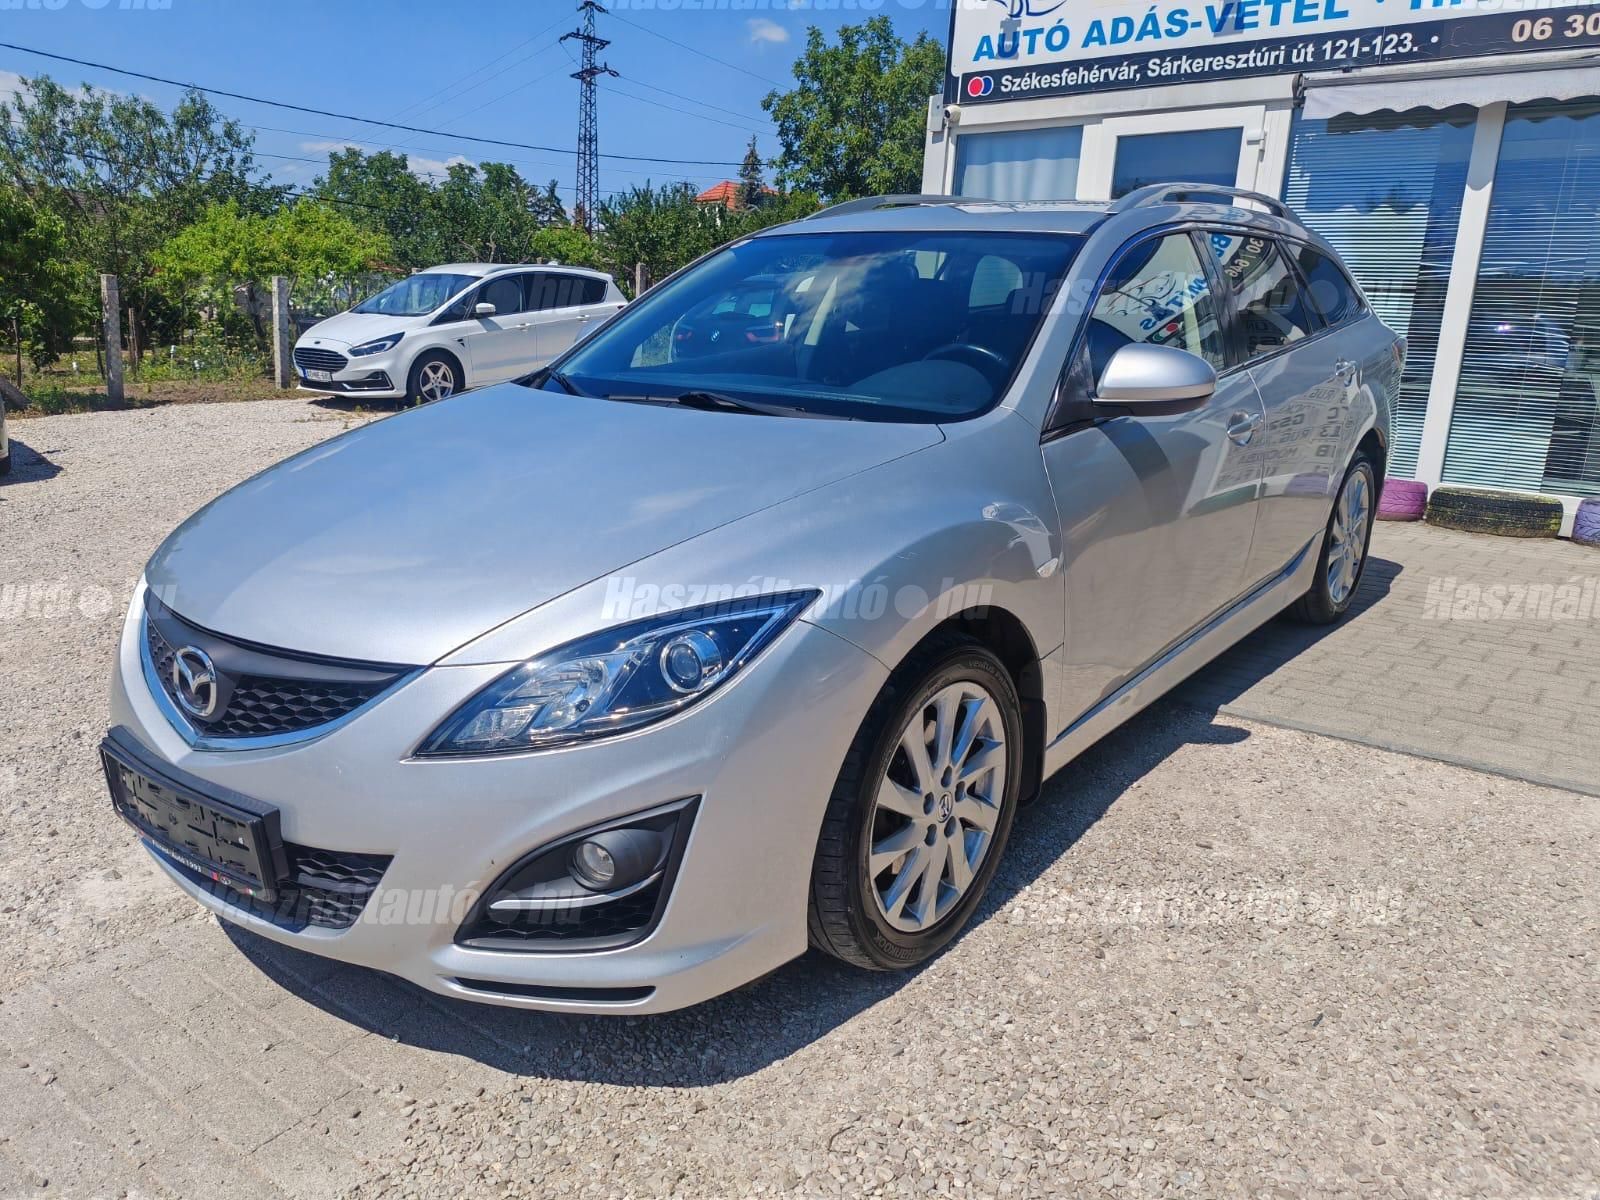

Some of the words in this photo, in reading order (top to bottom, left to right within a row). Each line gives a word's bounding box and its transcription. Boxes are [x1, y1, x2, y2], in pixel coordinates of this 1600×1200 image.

[972, 18, 1070, 62] AUTÓ
[1000, 63, 1141, 93] Székesfehérvár,
[1147, 45, 1284, 78] Sárkeresztúri
[1291, 42, 1314, 64] út
[1322, 32, 1419, 60] 121-123.
[1512, 17, 1553, 42] 06
[1563, 13, 1600, 38] 30
